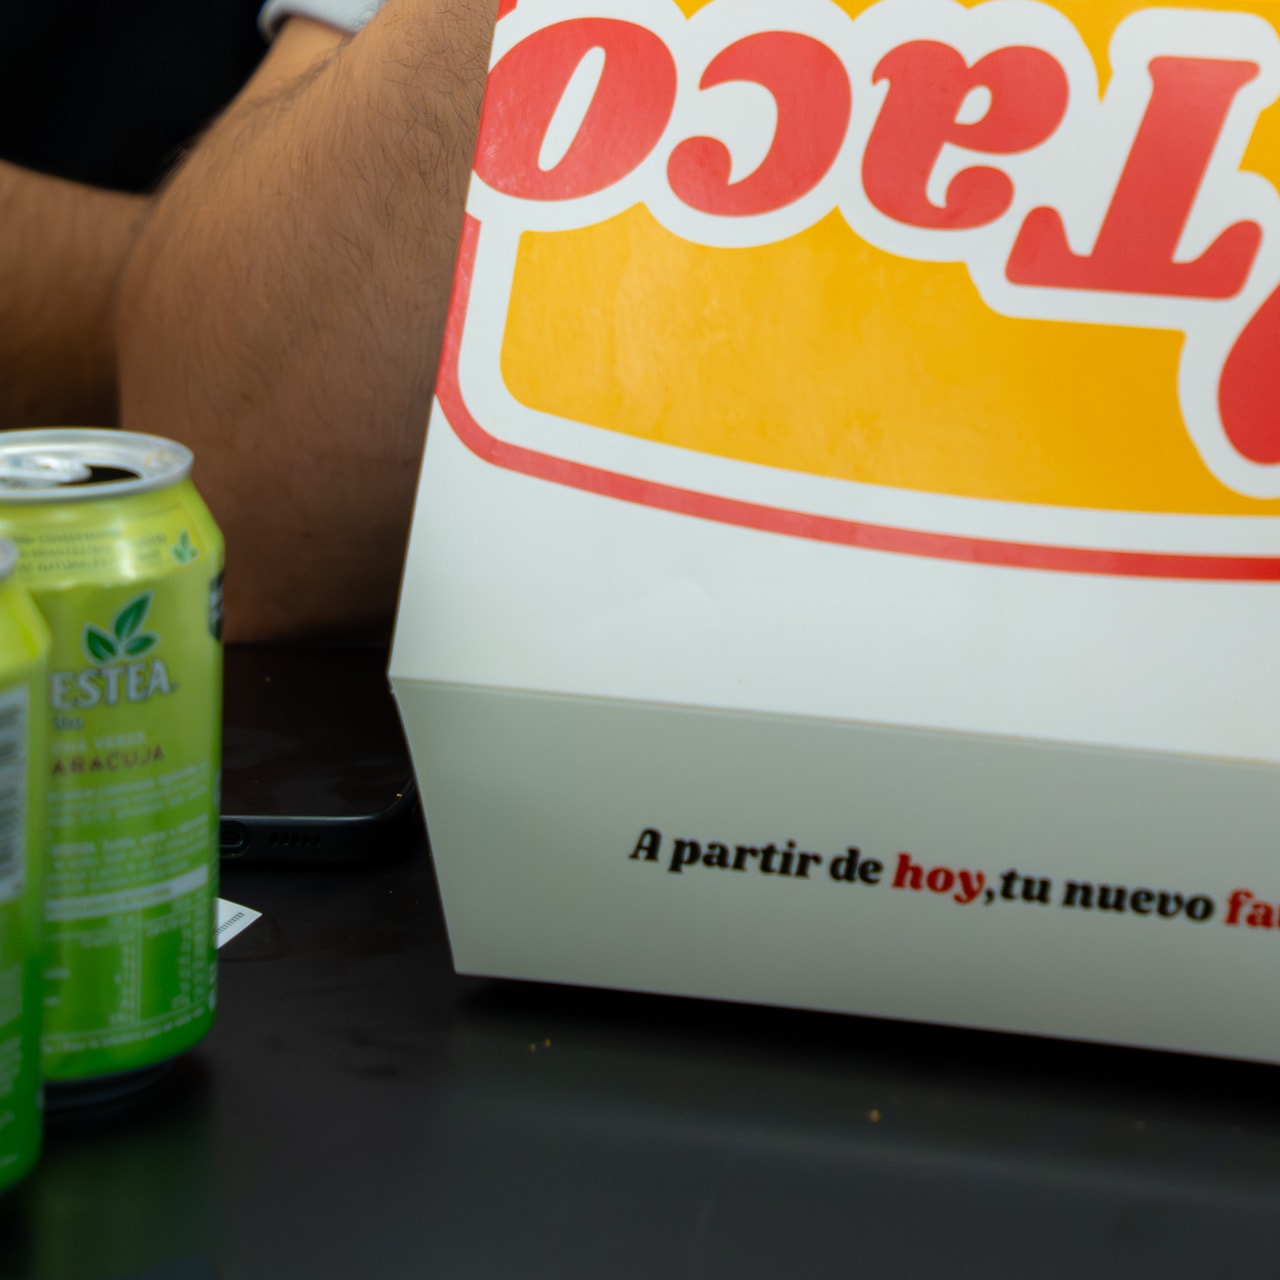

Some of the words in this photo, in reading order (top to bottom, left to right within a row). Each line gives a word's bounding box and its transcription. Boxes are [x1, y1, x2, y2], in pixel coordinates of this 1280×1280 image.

[50, 657, 170, 709] ESTEA
[628, 827, 663, 862] A
[667, 836, 823, 880] partir
[828, 845, 884, 885] de
[1061, 878, 1215, 923] nuevo
